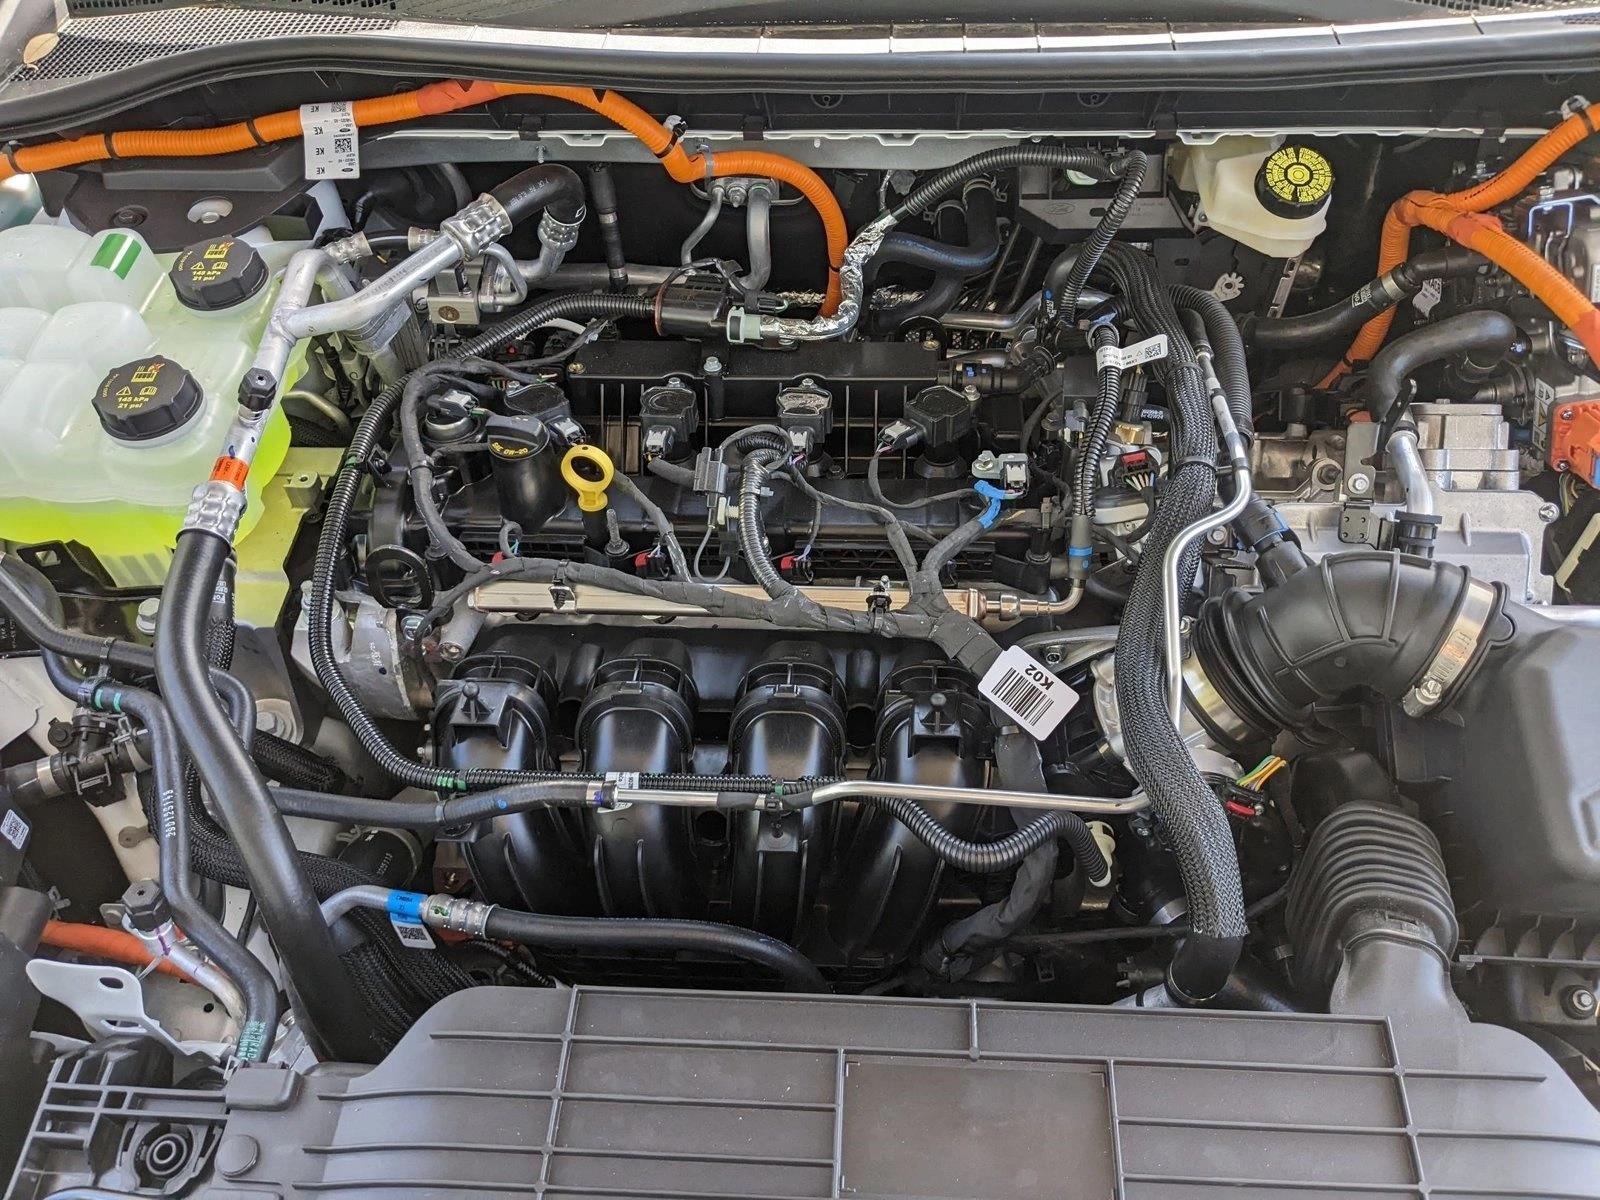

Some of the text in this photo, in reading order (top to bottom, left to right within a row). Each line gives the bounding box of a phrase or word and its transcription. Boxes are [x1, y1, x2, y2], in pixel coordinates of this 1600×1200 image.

[310, 105, 320, 113] KE
[313, 126, 324, 135] KE
[315, 147, 325, 156] KE
[316, 166, 326, 175] KE
[491, 442, 504, 452] SAE
[1024, 663, 1055, 691] K02
